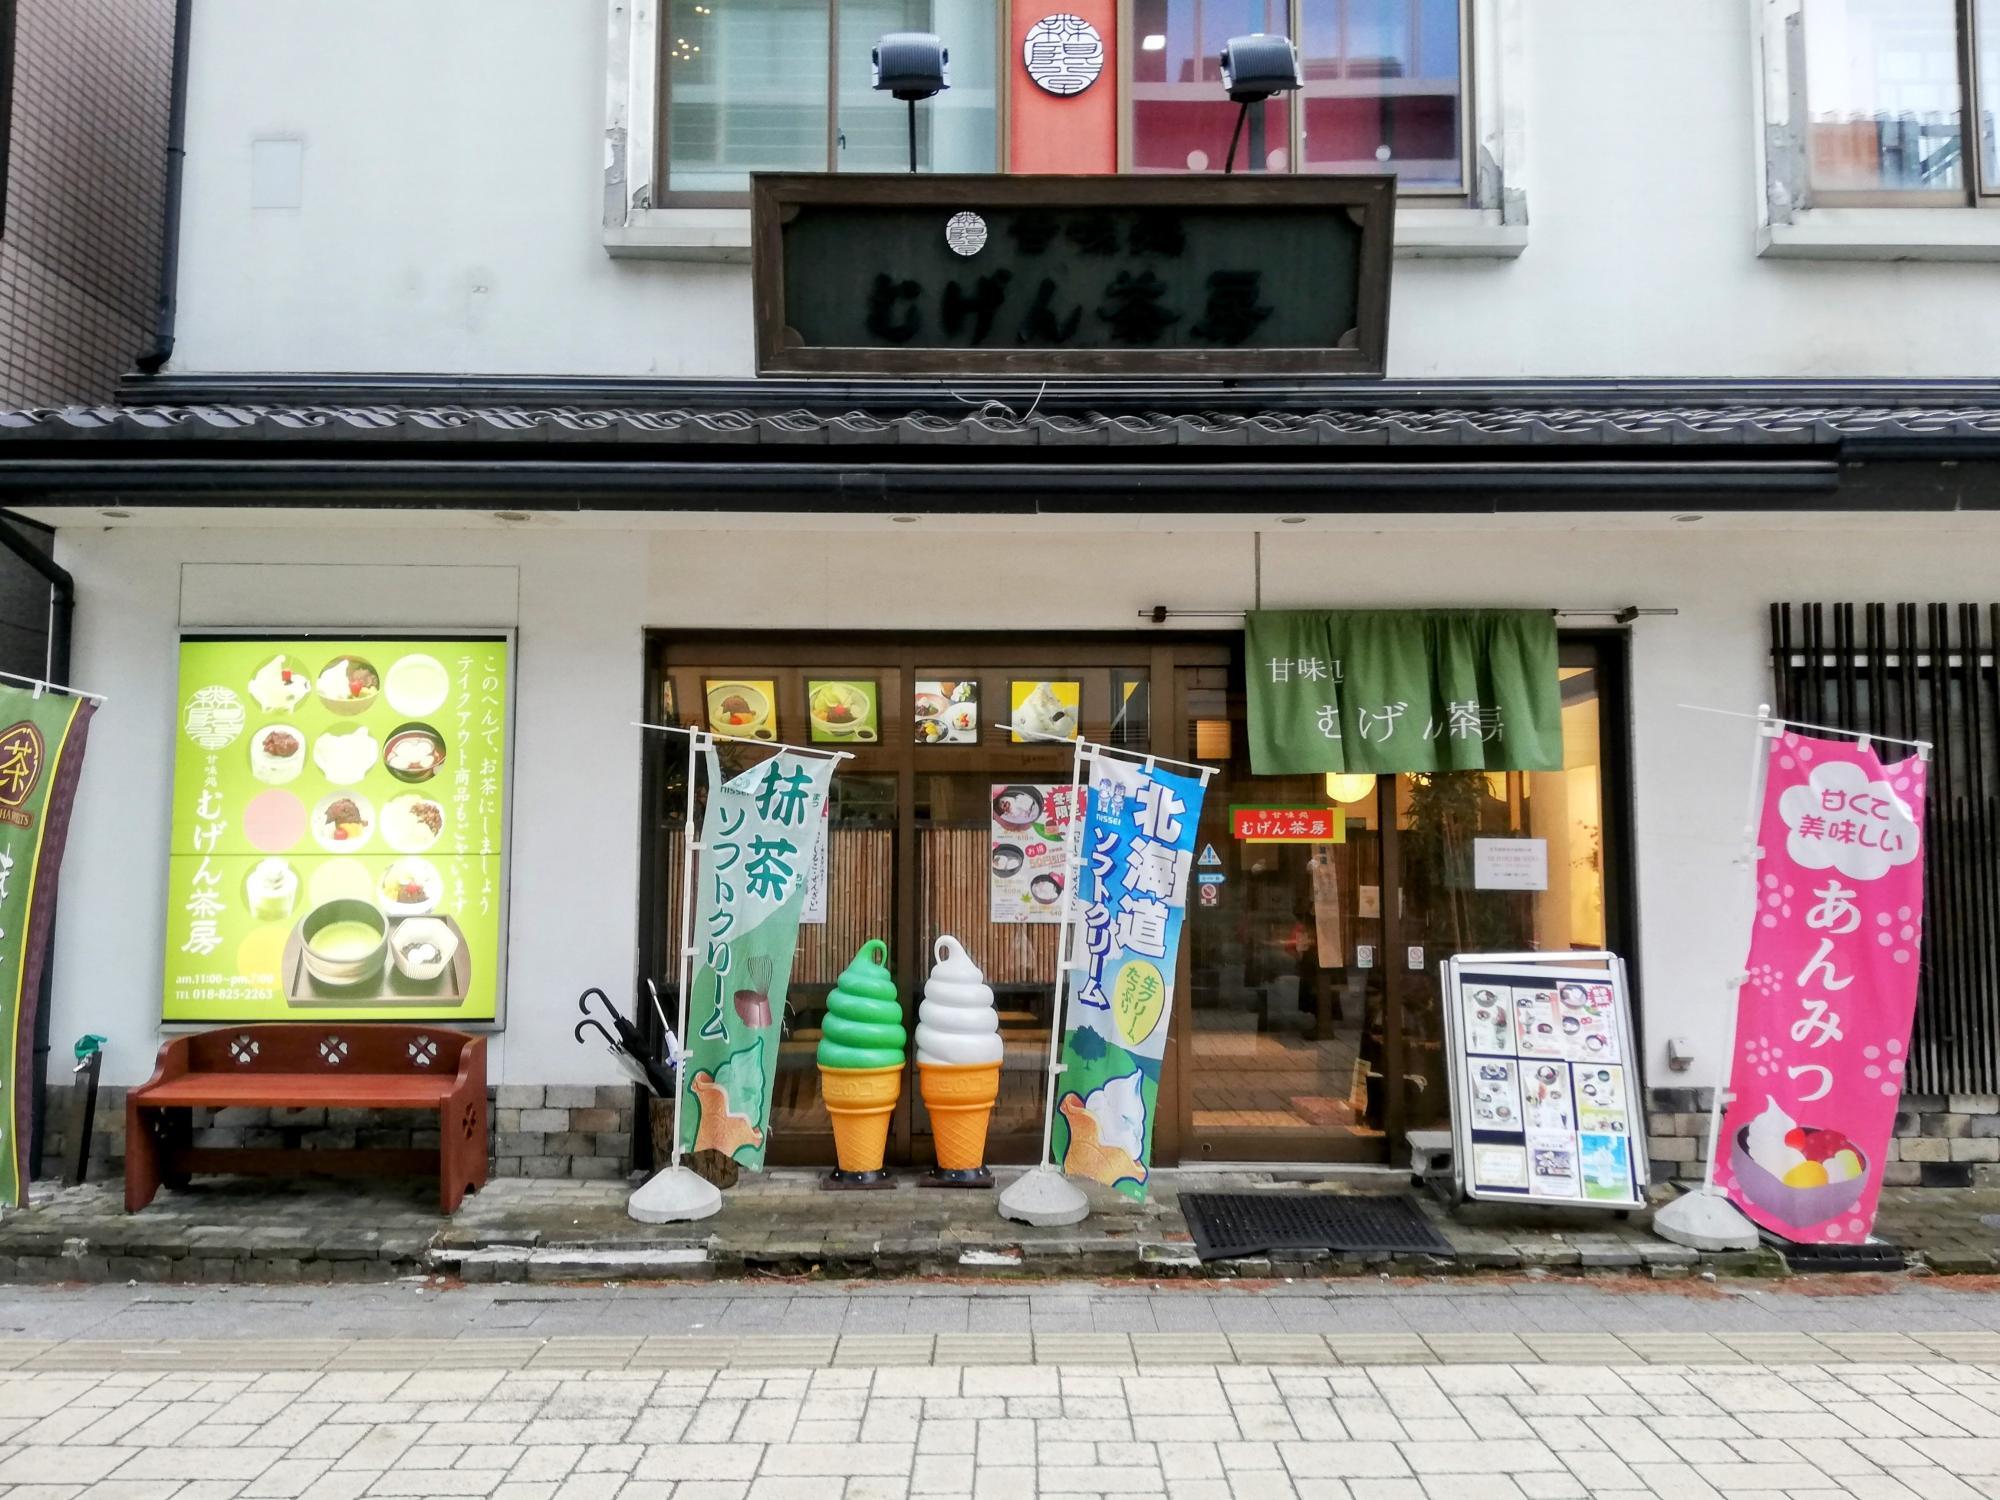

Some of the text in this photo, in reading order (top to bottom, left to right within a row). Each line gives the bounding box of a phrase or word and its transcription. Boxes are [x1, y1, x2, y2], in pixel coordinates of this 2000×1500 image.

[181, 789, 227, 956] むげん茶房
[744, 760, 814, 902] 抹茶
[1116, 780, 1186, 959] 北海道
[1241, 821, 1328, 836] むげん茶房
[1798, 814, 1903, 852] 美味しい
[1821, 788, 1891, 820] 甘くて
[700, 806, 746, 1043] ソフトクリーム
[1078, 828, 1121, 1011] ソフトクリーム
[1787, 880, 1862, 1102] あんみつ
[1127, 976, 1159, 1043] 生クリーム
